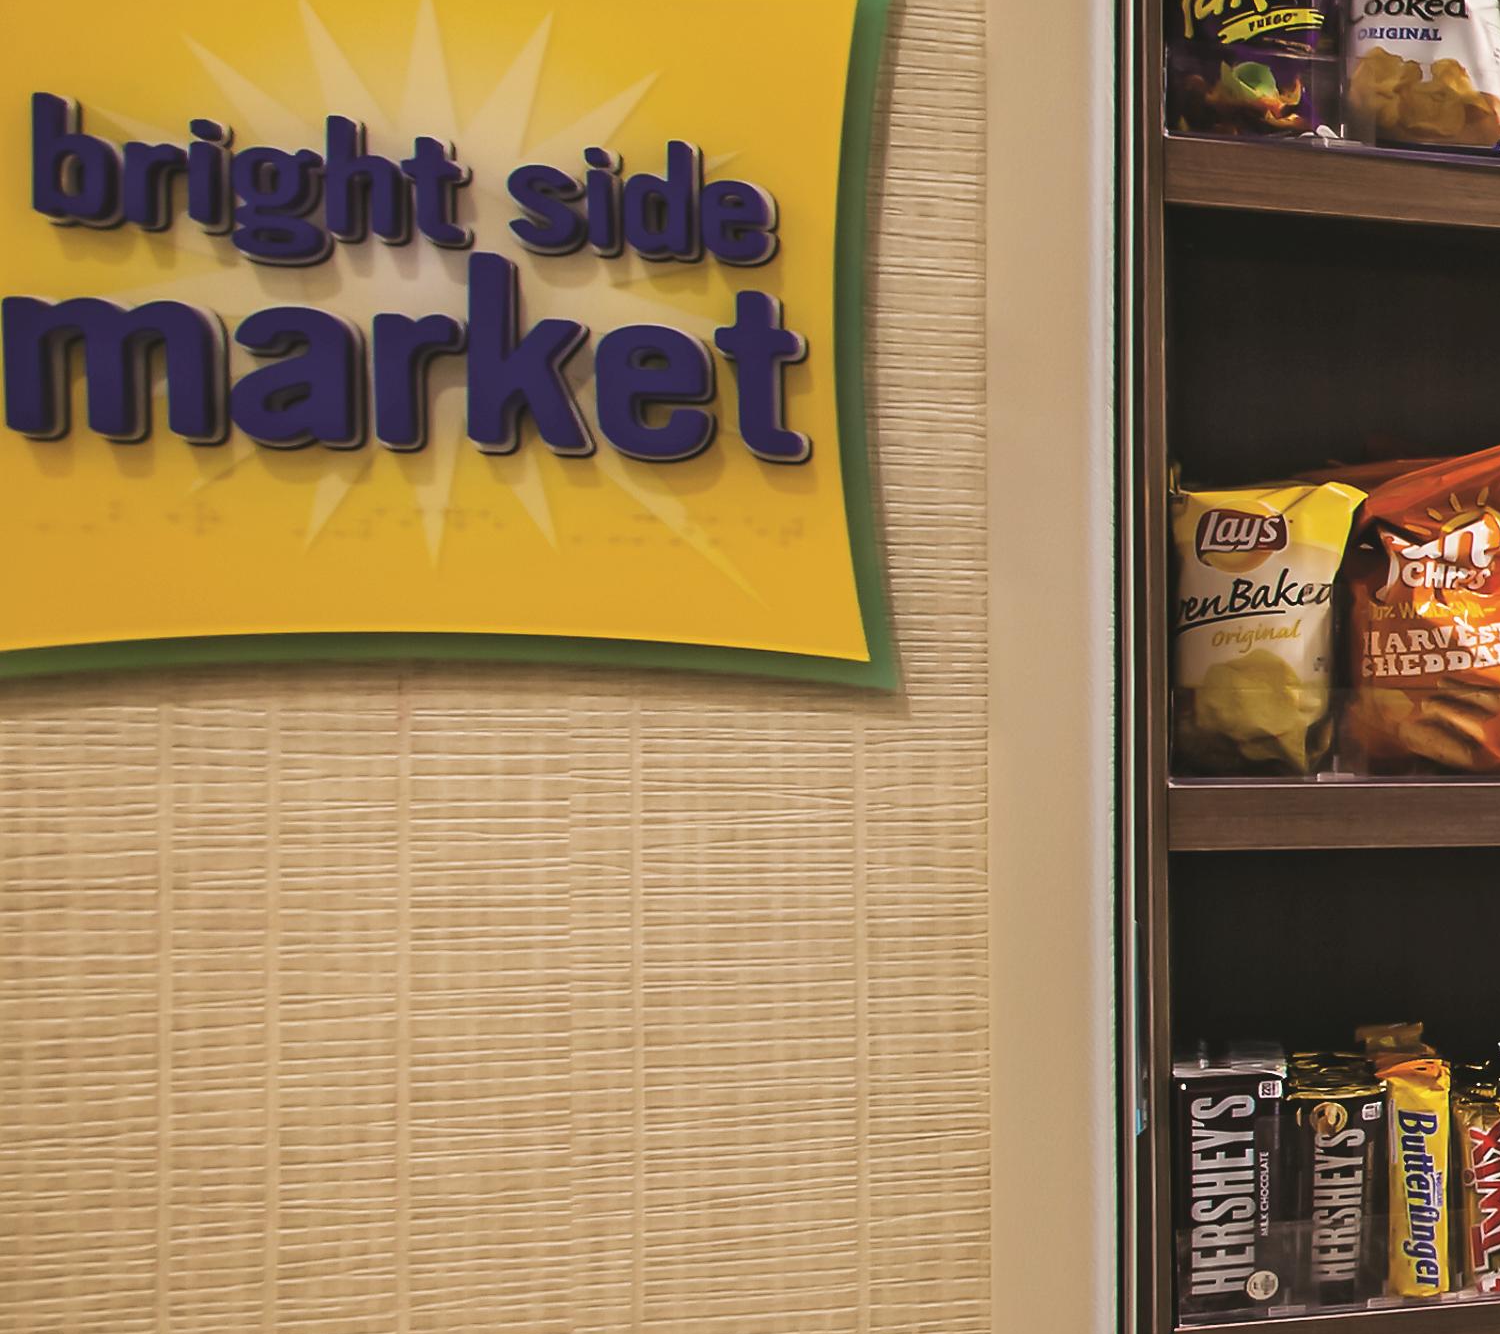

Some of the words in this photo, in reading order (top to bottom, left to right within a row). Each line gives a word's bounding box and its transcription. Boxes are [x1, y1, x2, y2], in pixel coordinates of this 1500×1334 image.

[1356, 25, 1443, 43] ORIGINAL
[31, 91, 470, 261] bright
[506, 139, 776, 262] side
[2, 251, 811, 462] market
[1191, 1094, 1256, 1296] HERSHEY'S
[1260, 1151, 1270, 1209] CHOCOLATE
[1311, 1127, 1366, 1285] HERSHEY'S
[1397, 1109, 1441, 1289] Butterfinger
